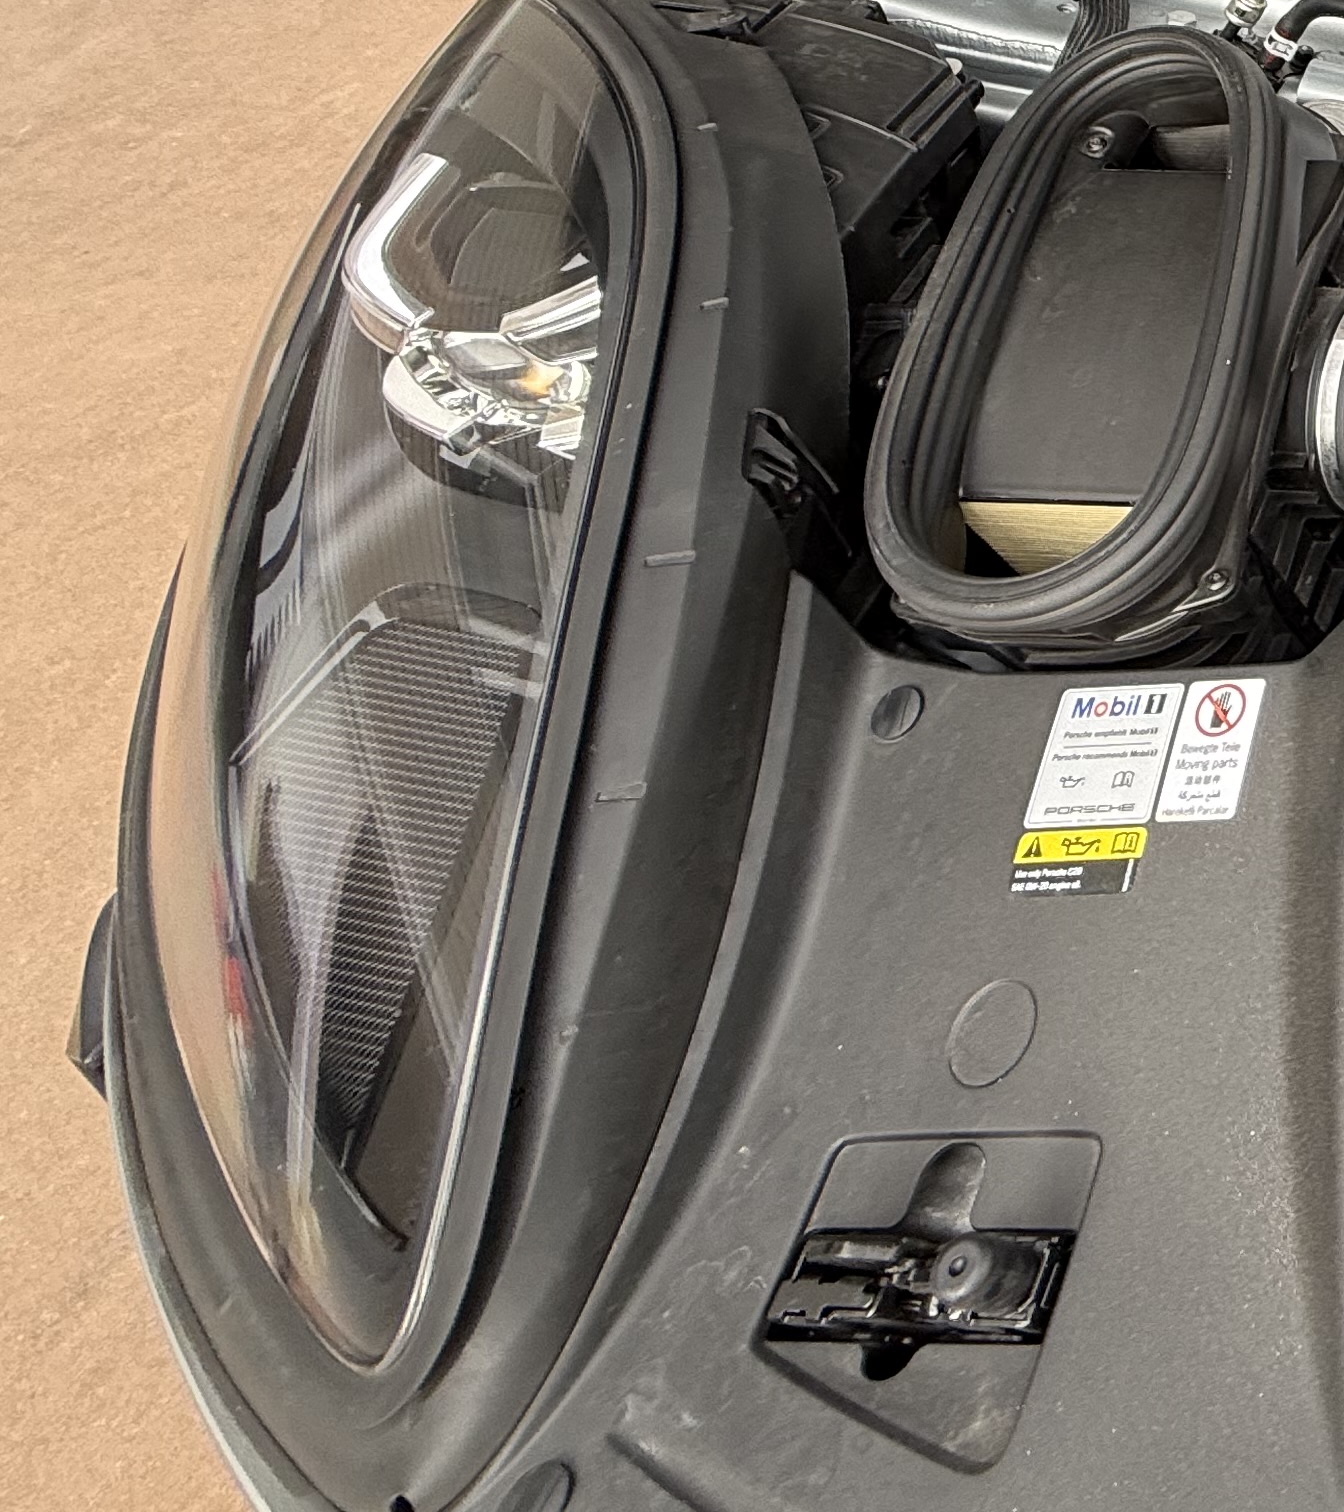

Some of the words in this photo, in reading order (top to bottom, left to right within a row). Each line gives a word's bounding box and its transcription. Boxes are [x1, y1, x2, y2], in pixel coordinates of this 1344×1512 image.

[1071, 694, 1142, 719] Mobil
[1144, 693, 1168, 715] 1
[1052, 753, 1081, 761] Porsche
[1175, 759, 1210, 771] Moving
[1212, 758, 1239, 770] parts
[1044, 803, 1136, 816] PORSCHE
